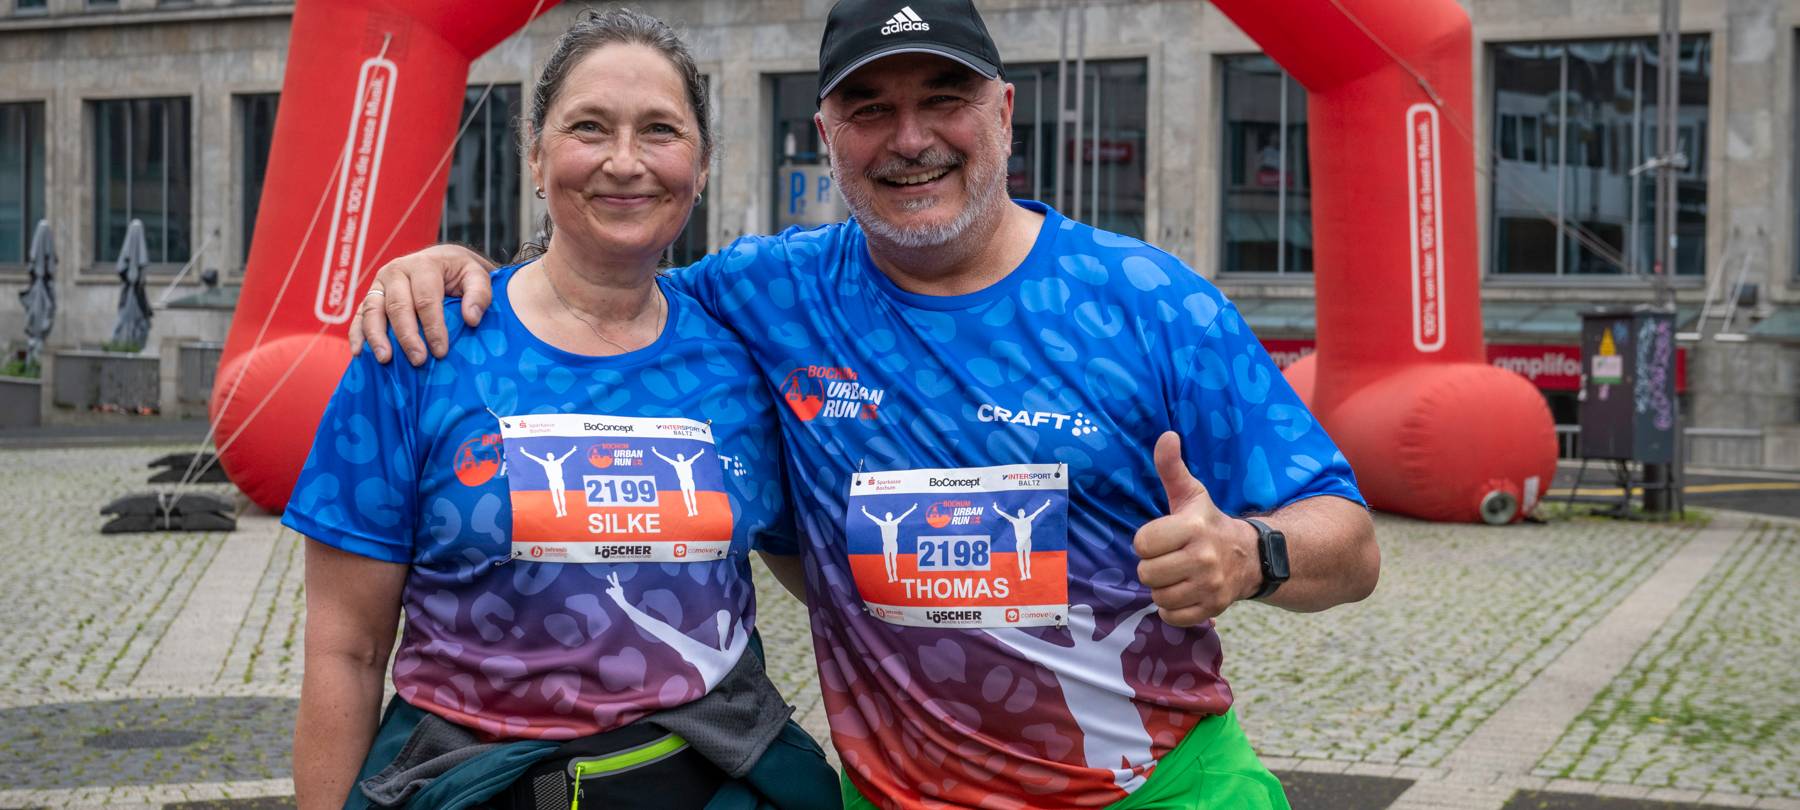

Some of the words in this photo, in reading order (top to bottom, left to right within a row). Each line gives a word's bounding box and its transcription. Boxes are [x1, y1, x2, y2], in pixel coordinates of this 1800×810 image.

[881, 21, 930, 35] adidas
[358, 118, 377, 154] beste
[354, 155, 370, 175] die
[347, 176, 366, 213] 100%
[1420, 214, 1434, 250] 100%
[339, 244, 353, 267] von
[329, 268, 348, 308] 100%
[1423, 301, 1436, 337] 100%
[1493, 352, 1582, 380] amplifo
[826, 381, 884, 406] URBAN
[823, 400, 861, 418] RUN
[977, 403, 1071, 430] CRAFT
[584, 423, 634, 433] BoConcept
[662, 424, 701, 432] INTERSPORT
[613, 449, 643, 457] URBAN
[614, 458, 632, 466] RUN
[586, 479, 656, 503] 2199
[929, 478, 981, 488] BoConcept
[951, 517, 970, 525] RUN
[953, 507, 983, 516] URBAN
[588, 513, 661, 534] SILKE
[595, 545, 651, 559] LÖSCHER
[919, 541, 989, 567] 2198
[900, 577, 1009, 599] THOMAS
[926, 610, 982, 623] LÖSCHER
